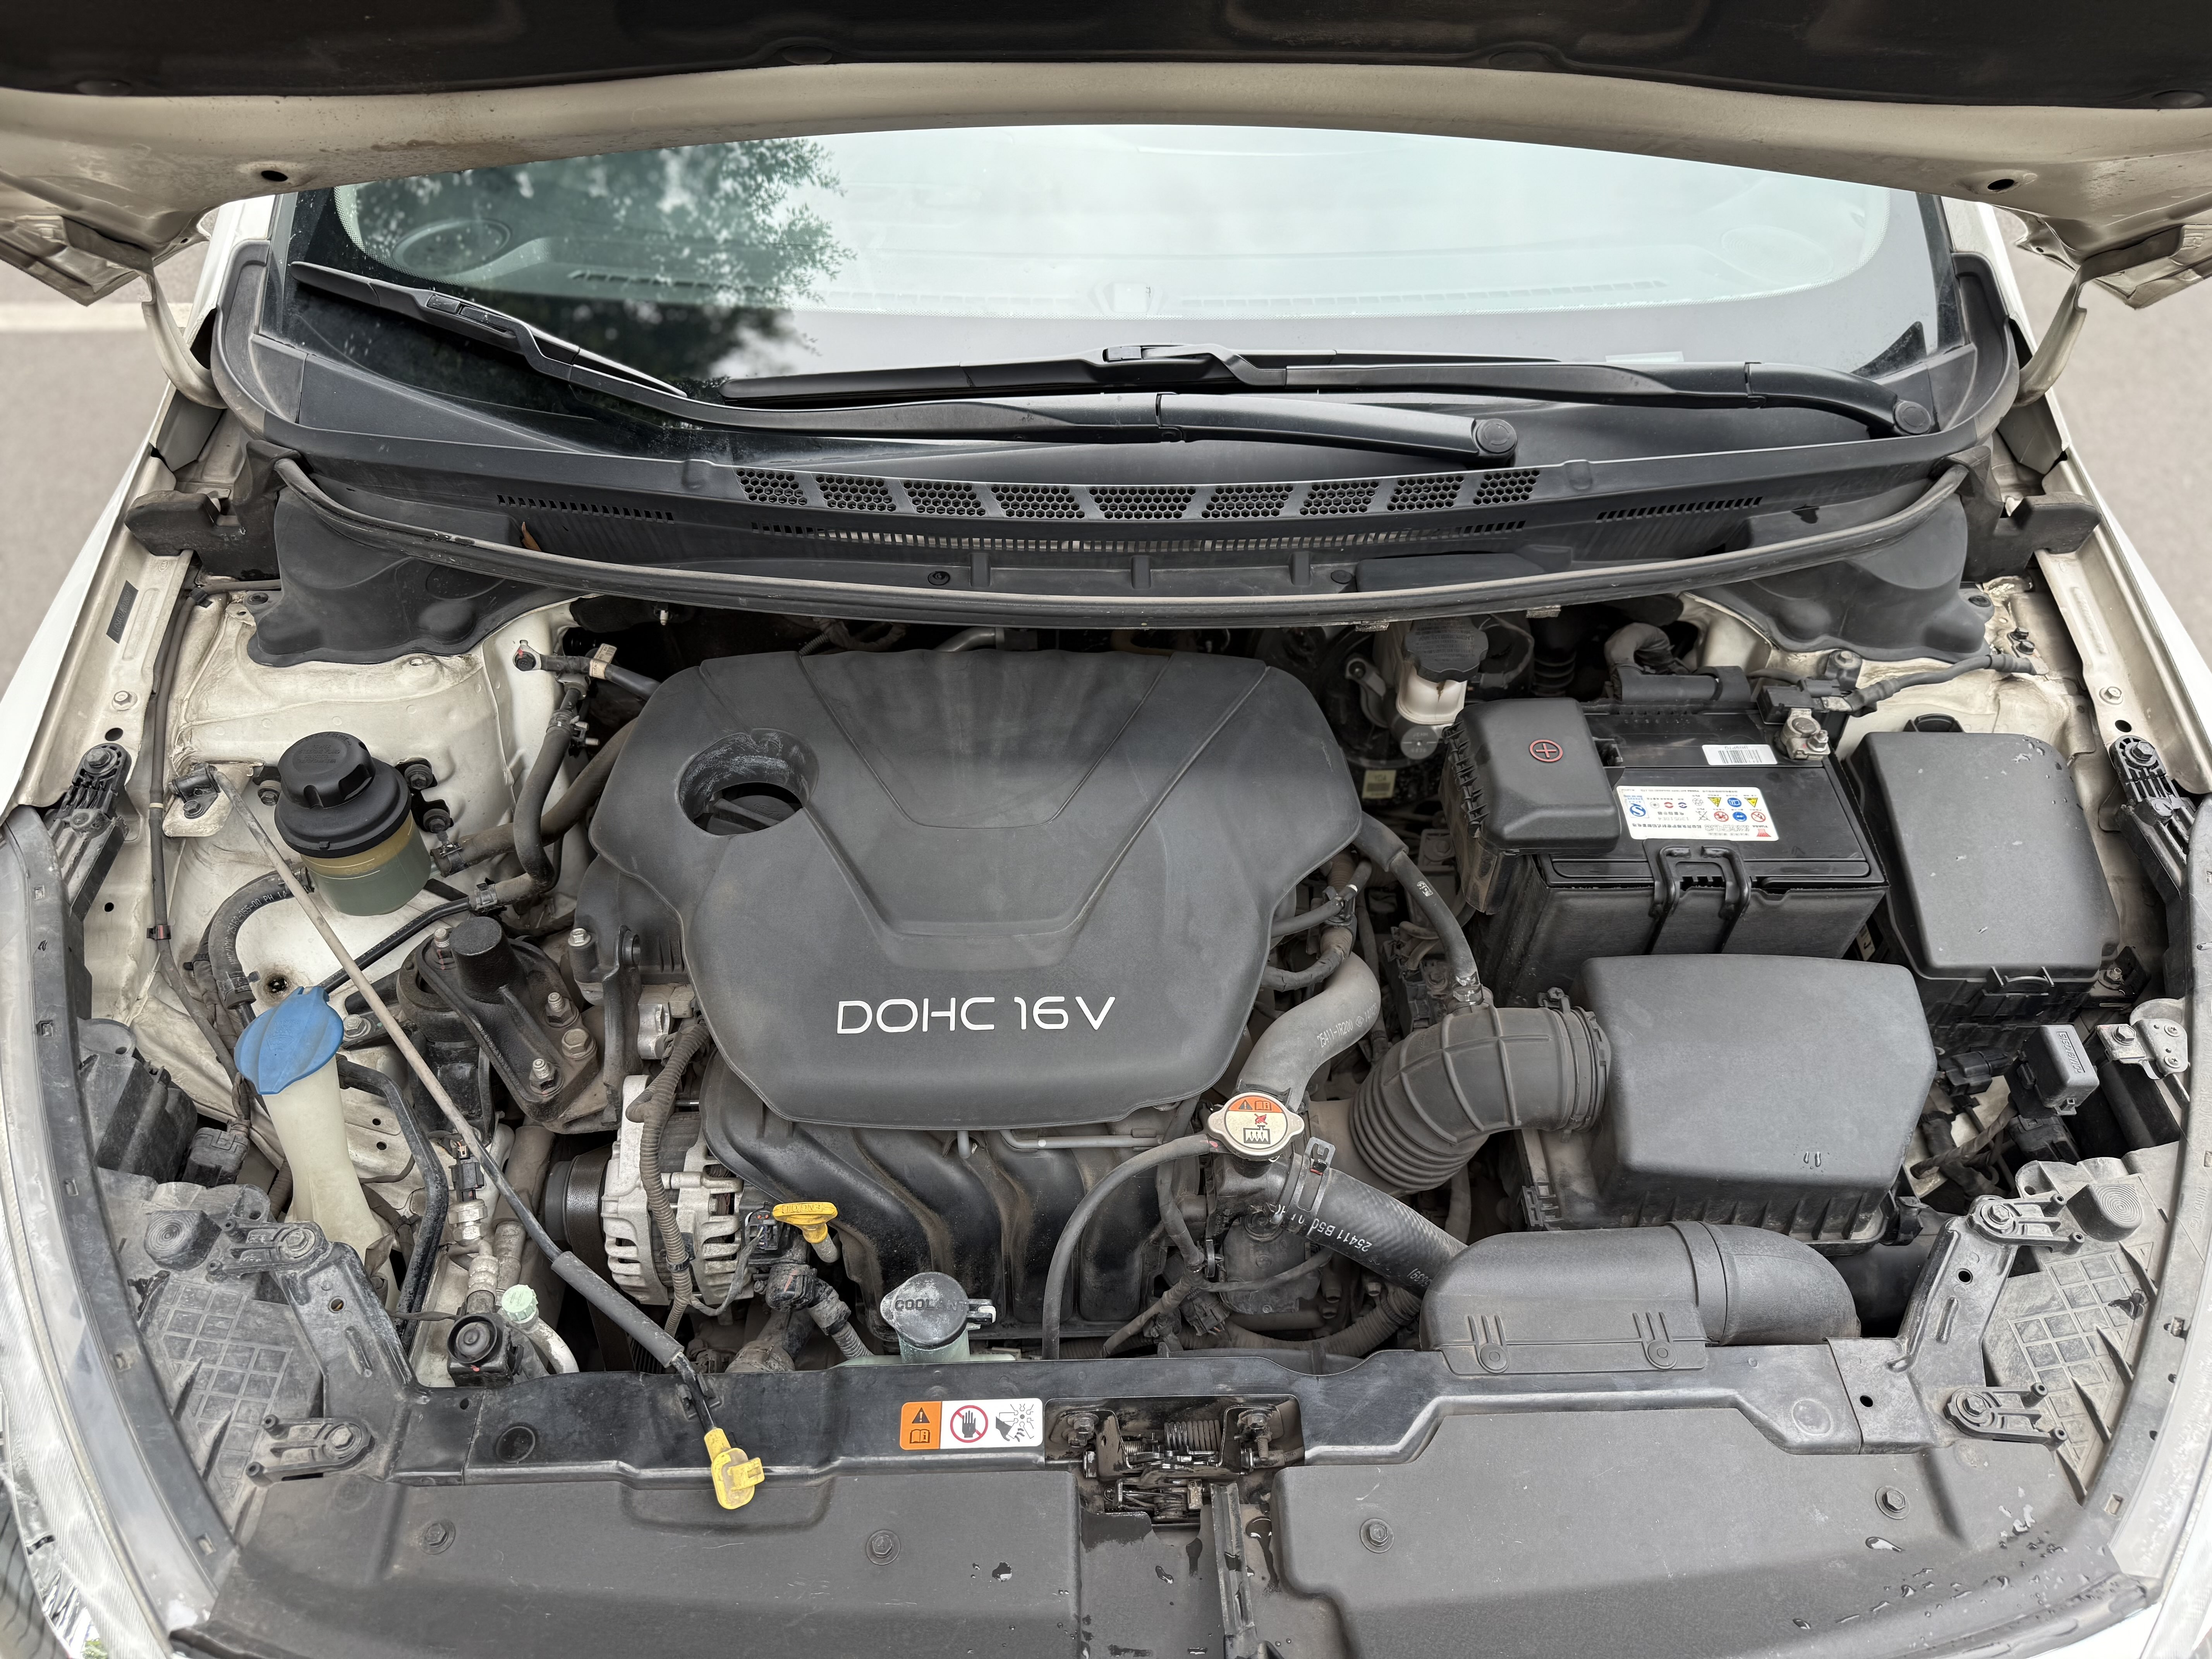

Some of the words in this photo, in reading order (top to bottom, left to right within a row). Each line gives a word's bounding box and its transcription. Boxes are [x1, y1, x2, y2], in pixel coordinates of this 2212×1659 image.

[344, 863, 375, 876] COLD
[837, 997, 996, 1034] DOHC
[1317, 1019, 1353, 1048] 25411-1R200
[783, 1204, 799, 1212] OIL
[800, 1204, 821, 1212] ENG
[2194, 1186, 2208, 1211] CHINA
[1336, 1229, 1373, 1252] 25411
[894, 1298, 969, 1313] COOLANT
